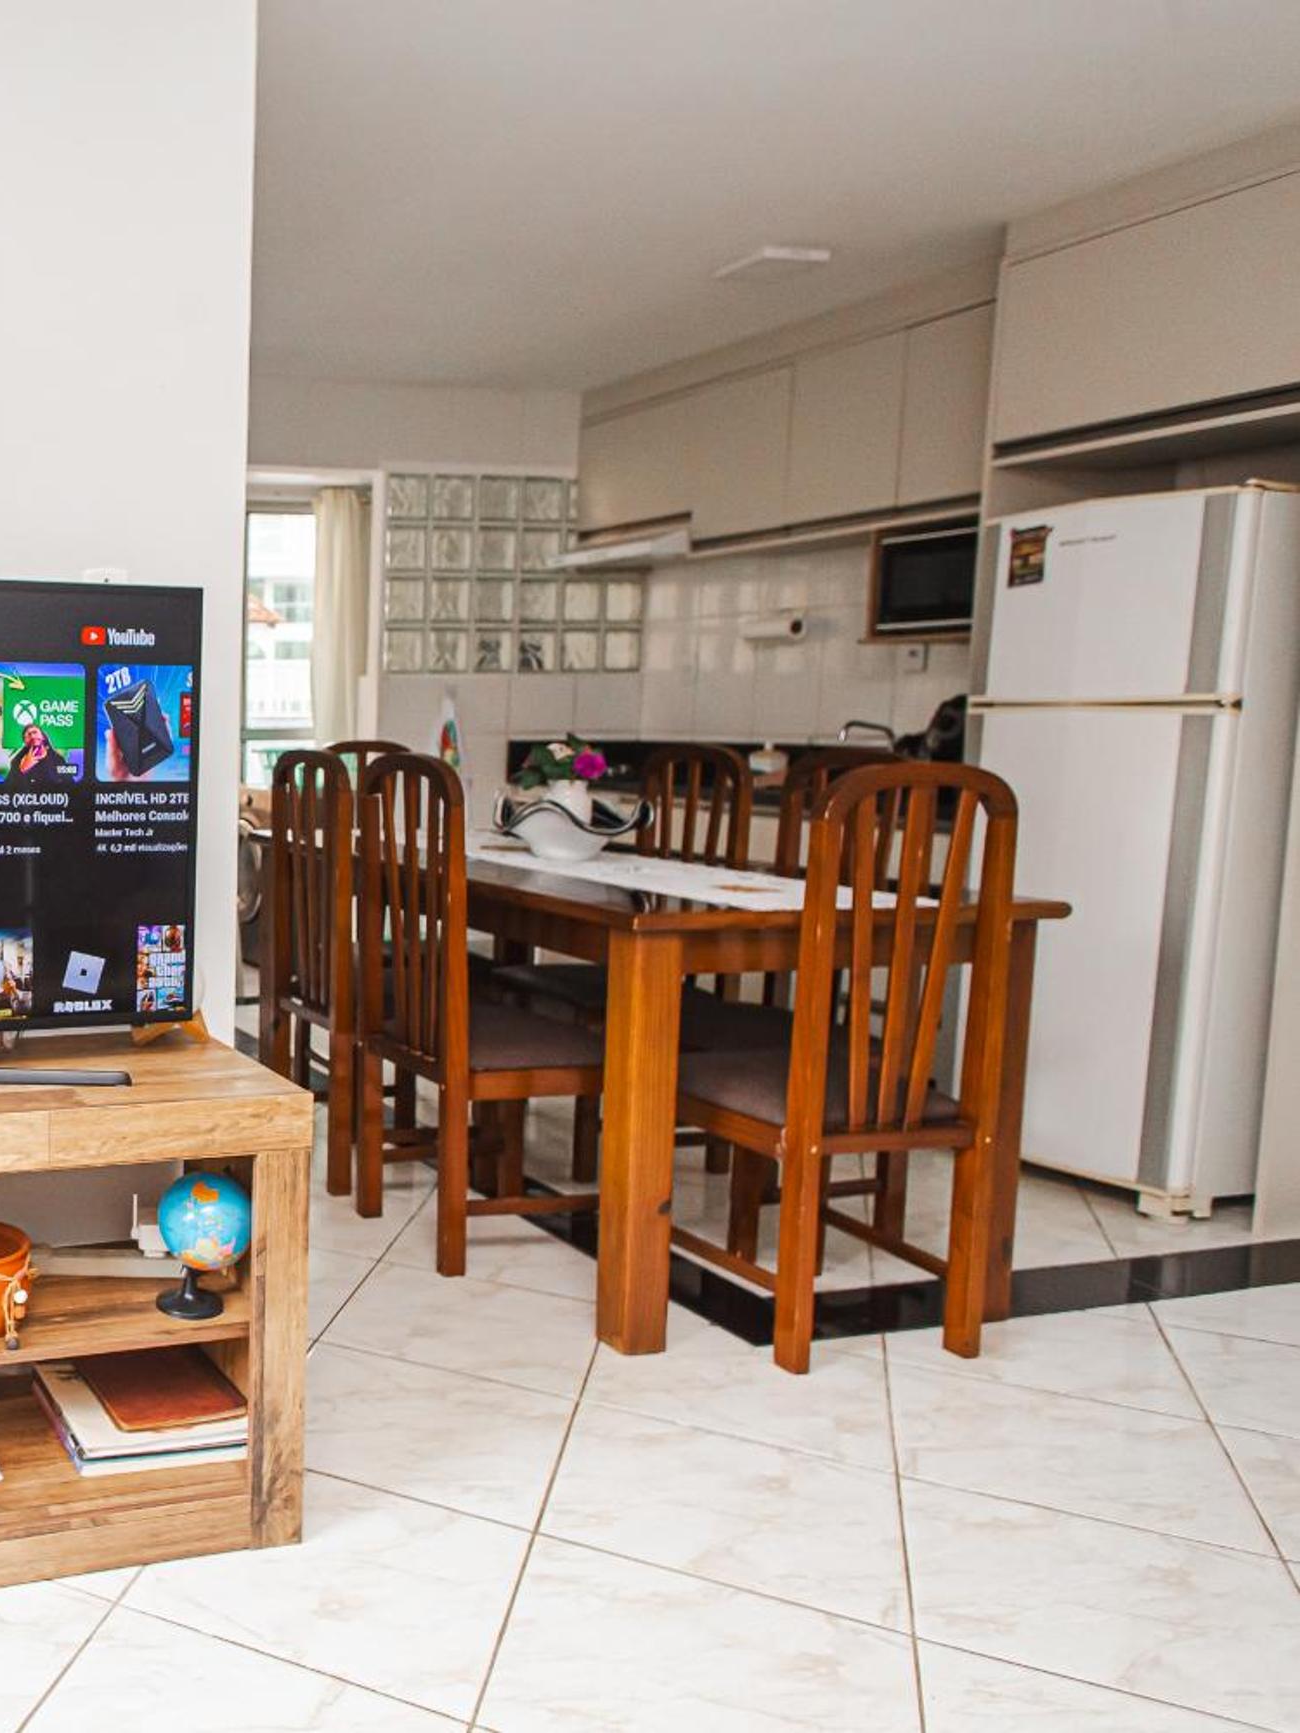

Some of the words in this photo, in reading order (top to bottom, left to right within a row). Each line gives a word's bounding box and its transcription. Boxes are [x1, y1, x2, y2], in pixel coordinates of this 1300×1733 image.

[107, 628, 155, 646] YouTube
[105, 667, 132, 694] 2TB
[40, 700, 79, 713] GAME
[40, 714, 74, 727] PASS
[12, 793, 69, 808] (XCLOUD)
[95, 790, 148, 804] INCRÍVEL
[150, 793, 167, 804] HD
[24, 814, 31, 823] e
[95, 810, 146, 822] Melhores
[53, 999, 113, 1013] ROBLOX
